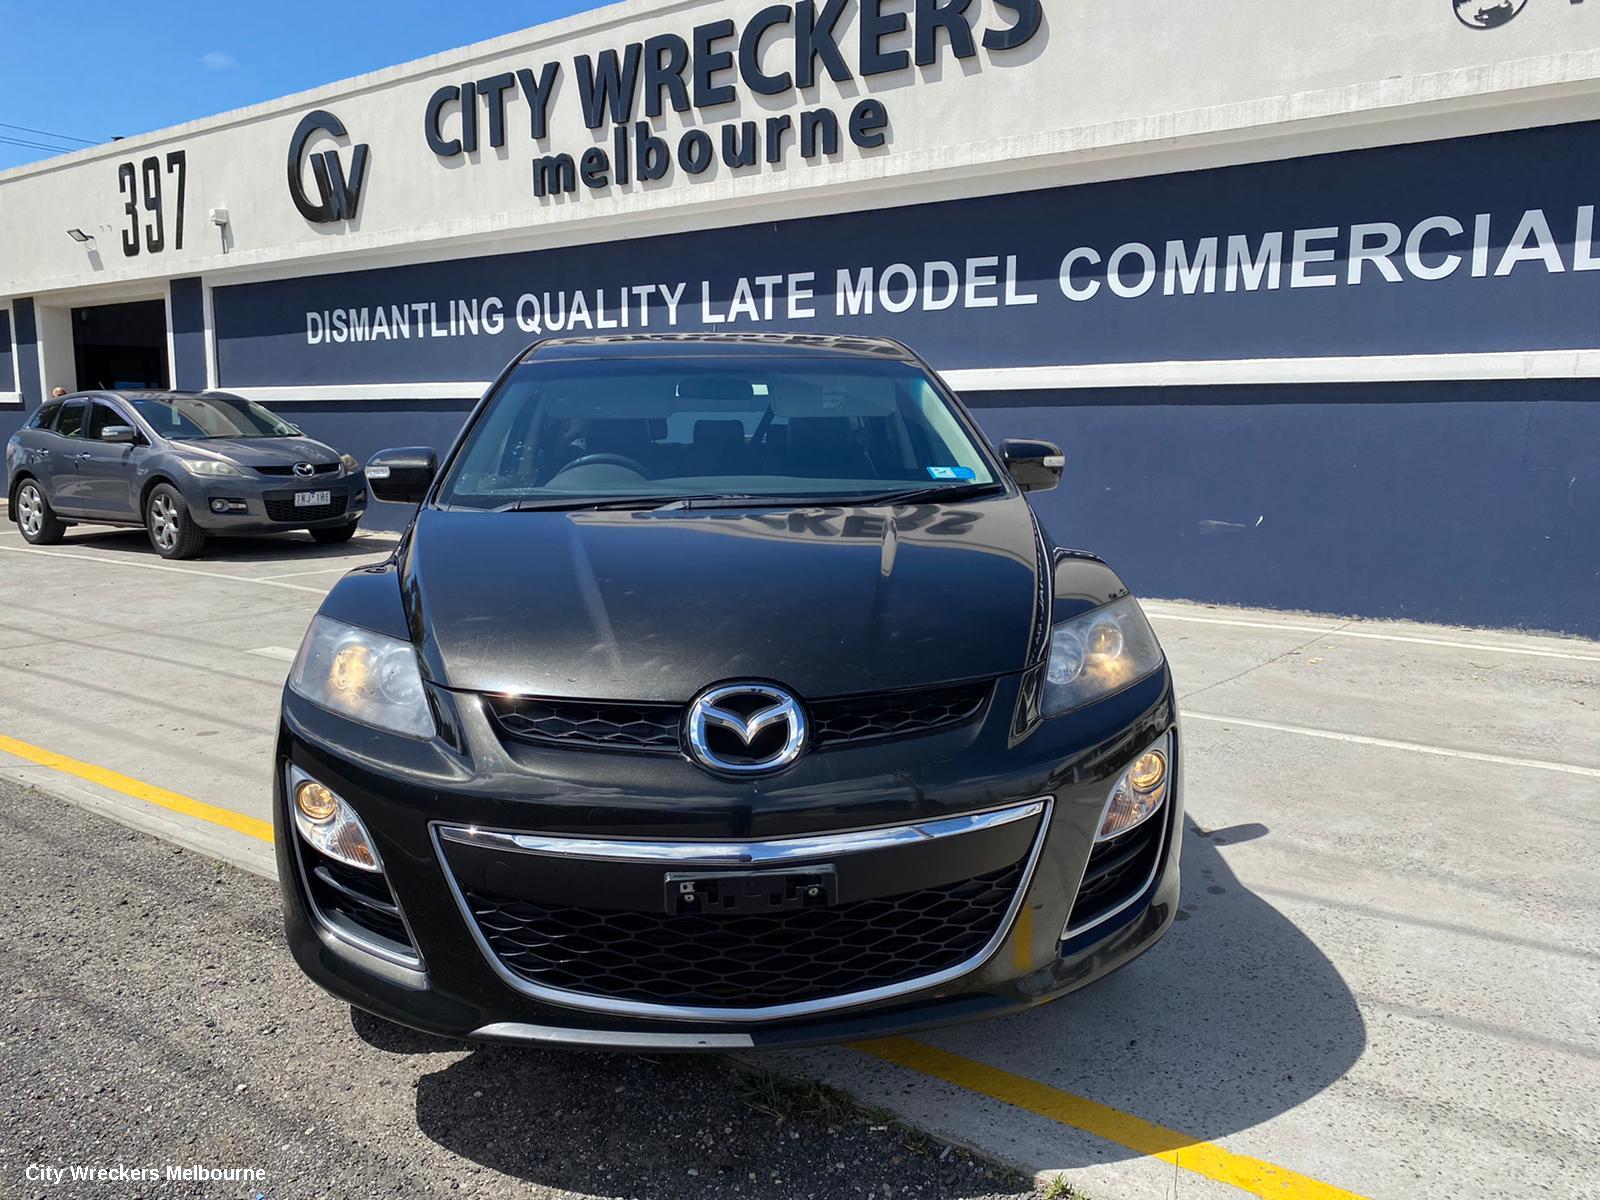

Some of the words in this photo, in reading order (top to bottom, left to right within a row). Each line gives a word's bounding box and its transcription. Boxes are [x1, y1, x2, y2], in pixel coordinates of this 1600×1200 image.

[425, 61, 560, 157] CITY
[574, 0, 1043, 128] WRECKERS
[118, 150, 186, 257] 397
[532, 98, 888, 196] melbourne
[305, 296, 505, 345] DISMANTLING
[515, 282, 686, 335] QUALITY
[701, 272, 816, 324] LATE
[836, 255, 1037, 316] MODEL
[1058, 205, 1600, 301] COMMERCIAL
